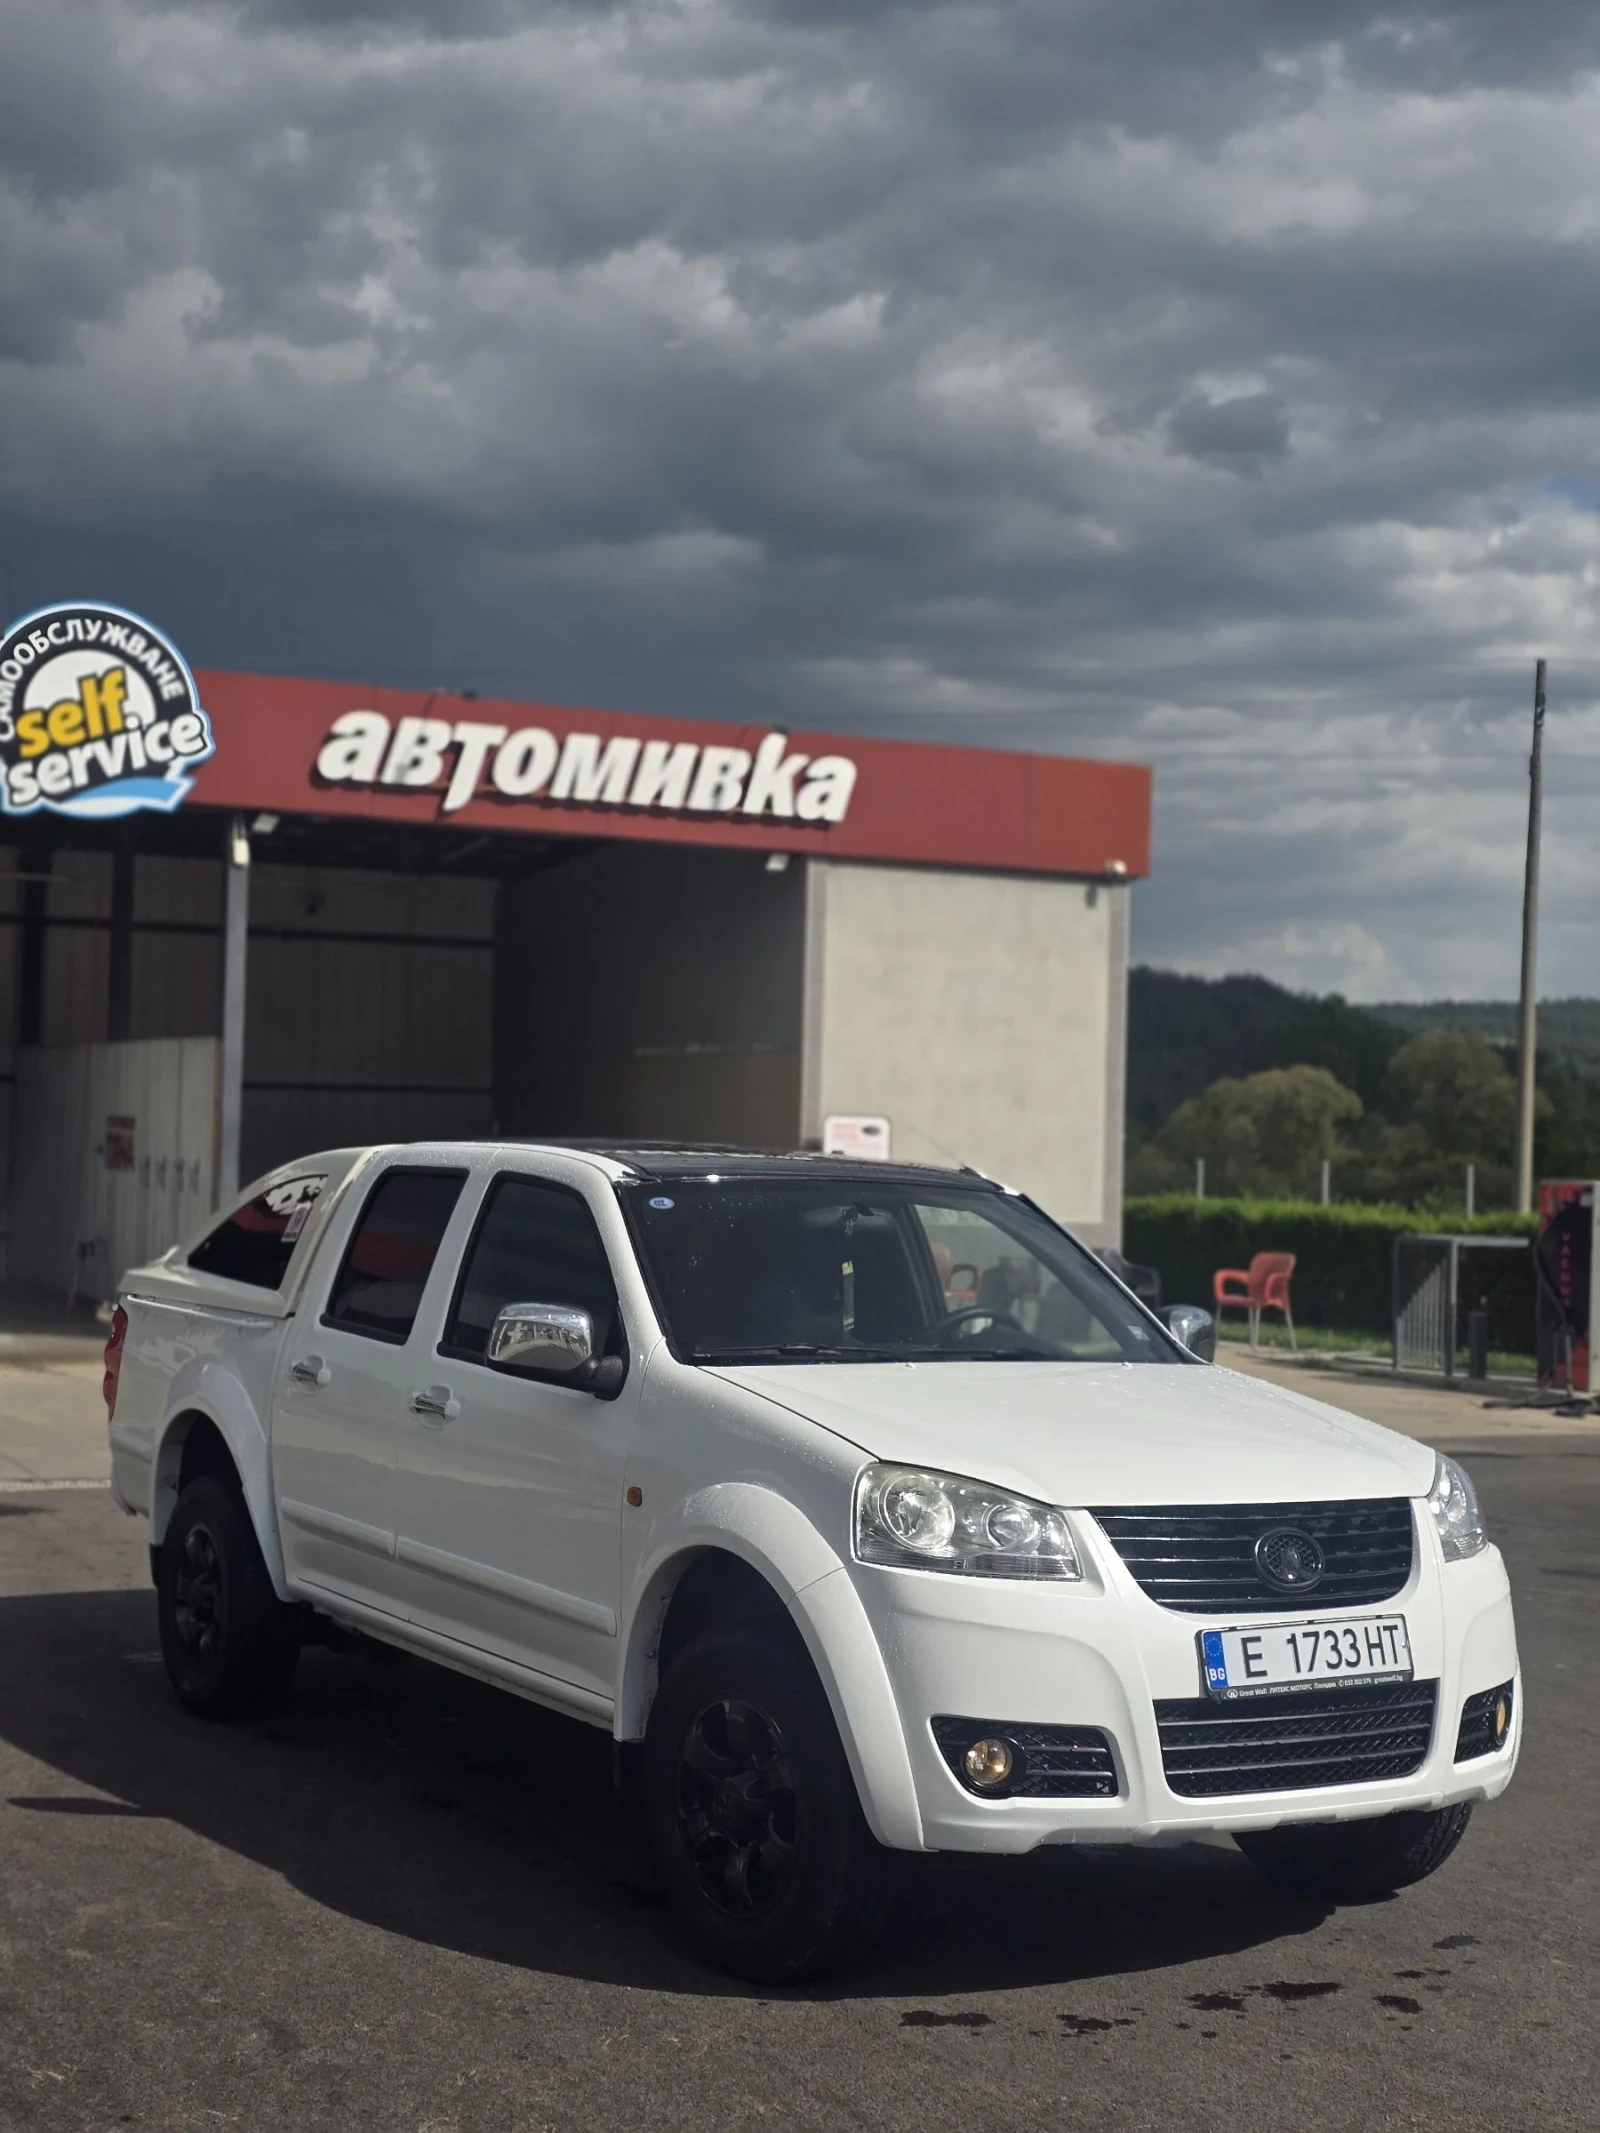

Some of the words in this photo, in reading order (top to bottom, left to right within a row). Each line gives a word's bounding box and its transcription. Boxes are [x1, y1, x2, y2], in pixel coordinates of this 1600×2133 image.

[16, 666, 126, 758] self
[8, 713, 204, 803] service
[317, 710, 857, 822] автомивка
[1209, 1667, 1226, 1681] BG
[1241, 1636, 1267, 1678] E
